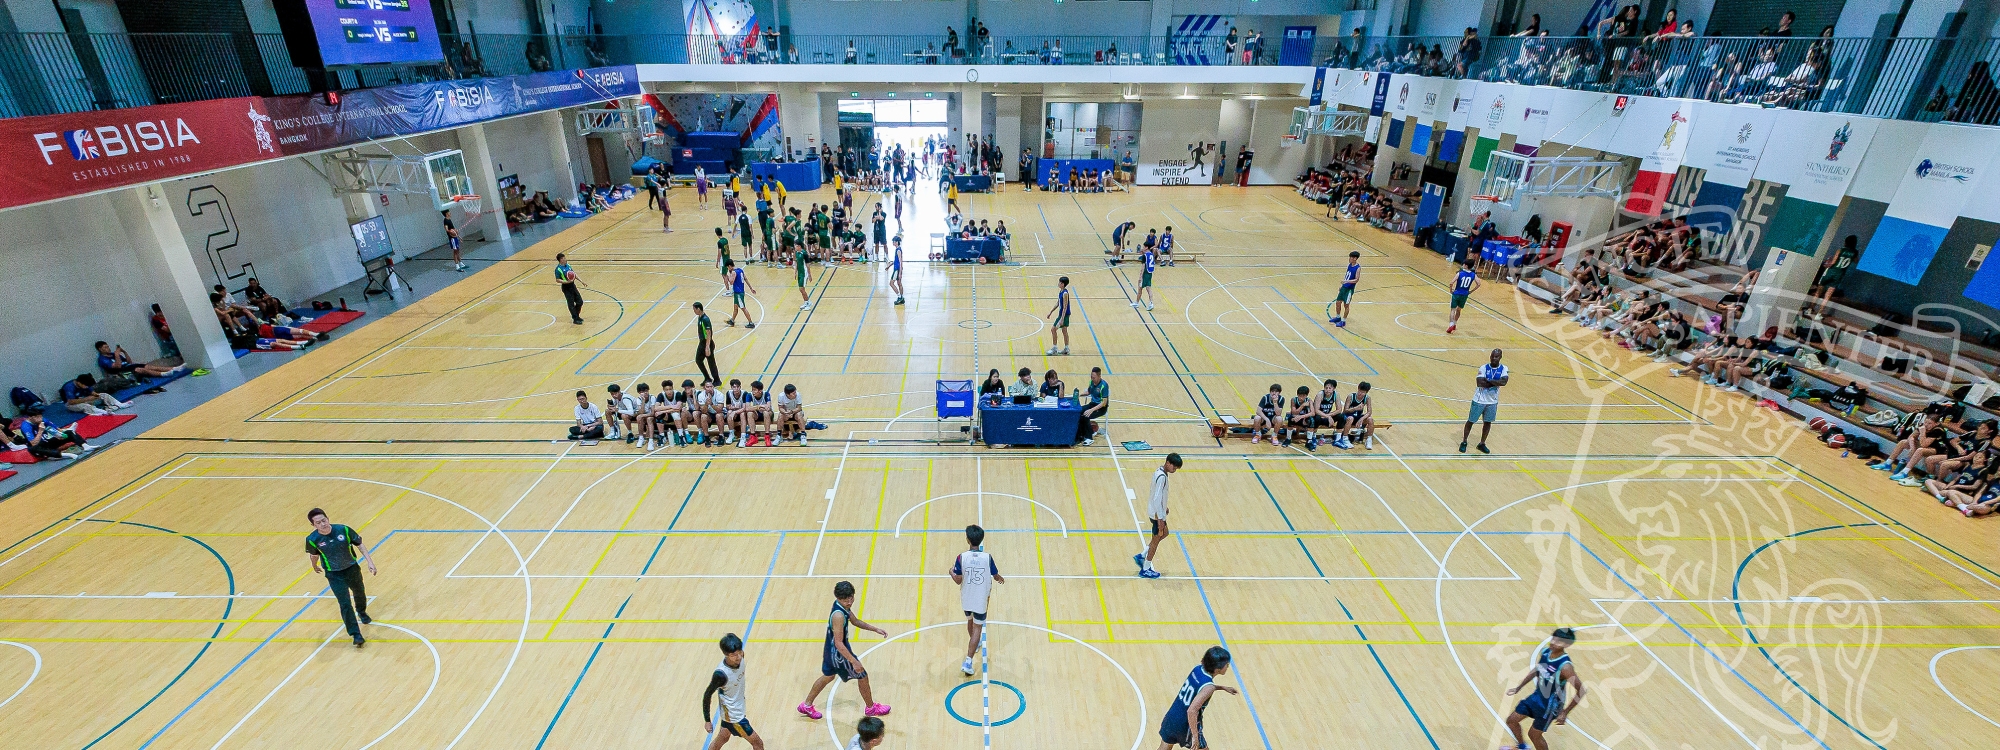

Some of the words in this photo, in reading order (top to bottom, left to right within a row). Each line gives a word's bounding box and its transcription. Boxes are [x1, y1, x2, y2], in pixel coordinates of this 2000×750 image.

[373, 27, 392, 42] VS
[273, 116, 301, 131] KING'S
[301, 113, 335, 126] COLLEGE
[335, 106, 384, 122] INTERNATIONAL
[384, 104, 408, 115] SCHOOL
[279, 134, 309, 145] BANGKOK
[72, 161, 149, 182] ESTABLISHED
[153, 158, 164, 168] IN
[169, 154, 192, 166] 1988
[1158, 159, 1187, 167] ENGAGE
[1933, 162, 1953, 171] BRITISH
[1952, 165, 1975, 175] SCHOOL
[1152, 168, 1181, 176] INSPIRE
[1929, 169, 1950, 178] MANILA
[1161, 177, 1190, 185] EXTEND
[1163, 237, 1170, 247] 5
[1148, 254, 1154, 267] 2
[1836, 256, 1851, 269] 10
[1460, 276, 1472, 288] 10
[964, 566, 986, 585] 13
[1179, 678, 1195, 706] 20
